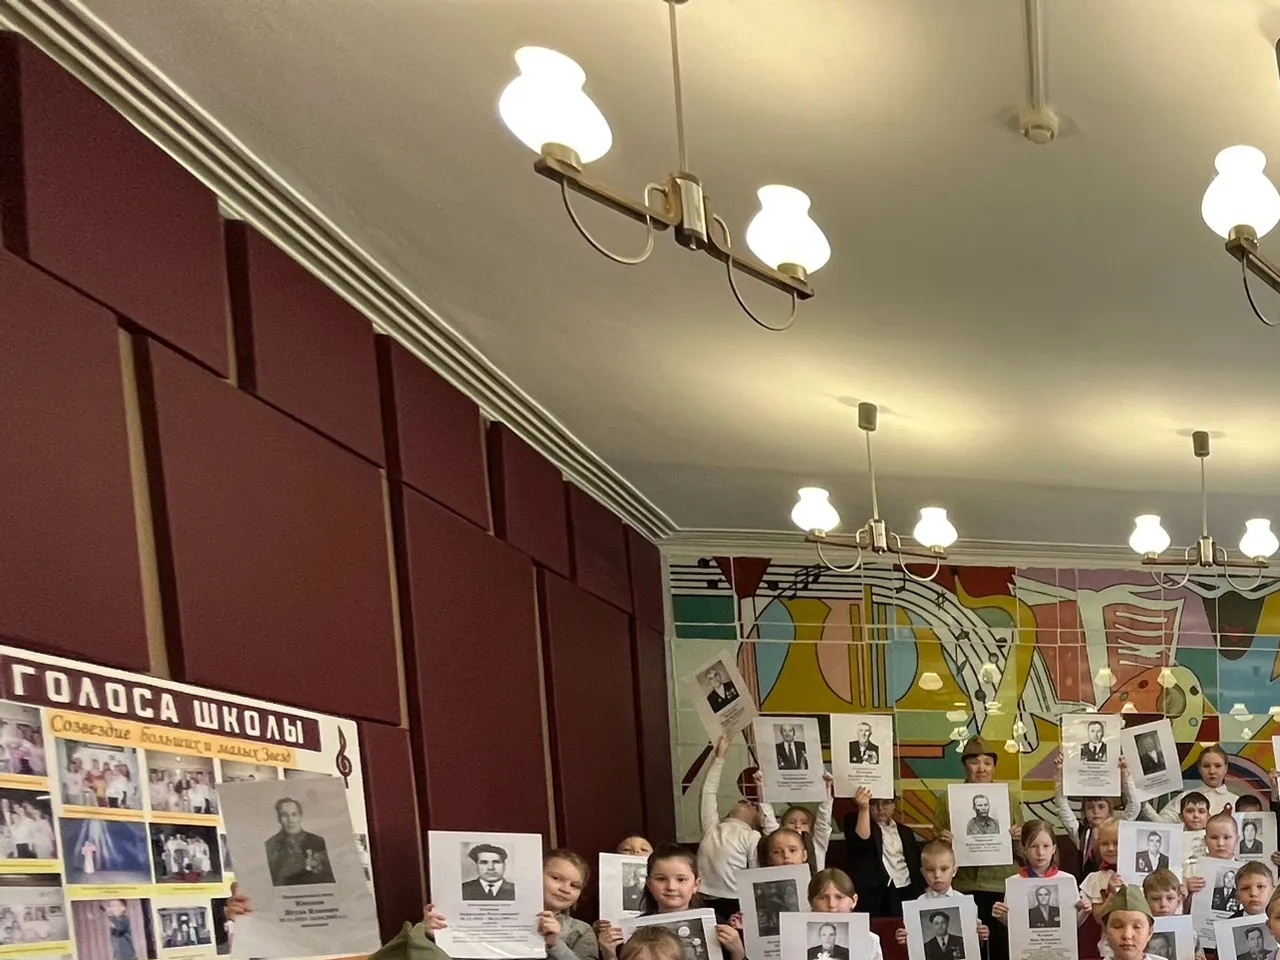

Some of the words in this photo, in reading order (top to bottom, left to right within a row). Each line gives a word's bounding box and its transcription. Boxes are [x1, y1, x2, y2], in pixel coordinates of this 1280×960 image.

[11, 664, 179, 723] ГОЛОСА
[193, 699, 305, 744] ШКОЛЫ
[51, 714, 131, 740] Созвездие
